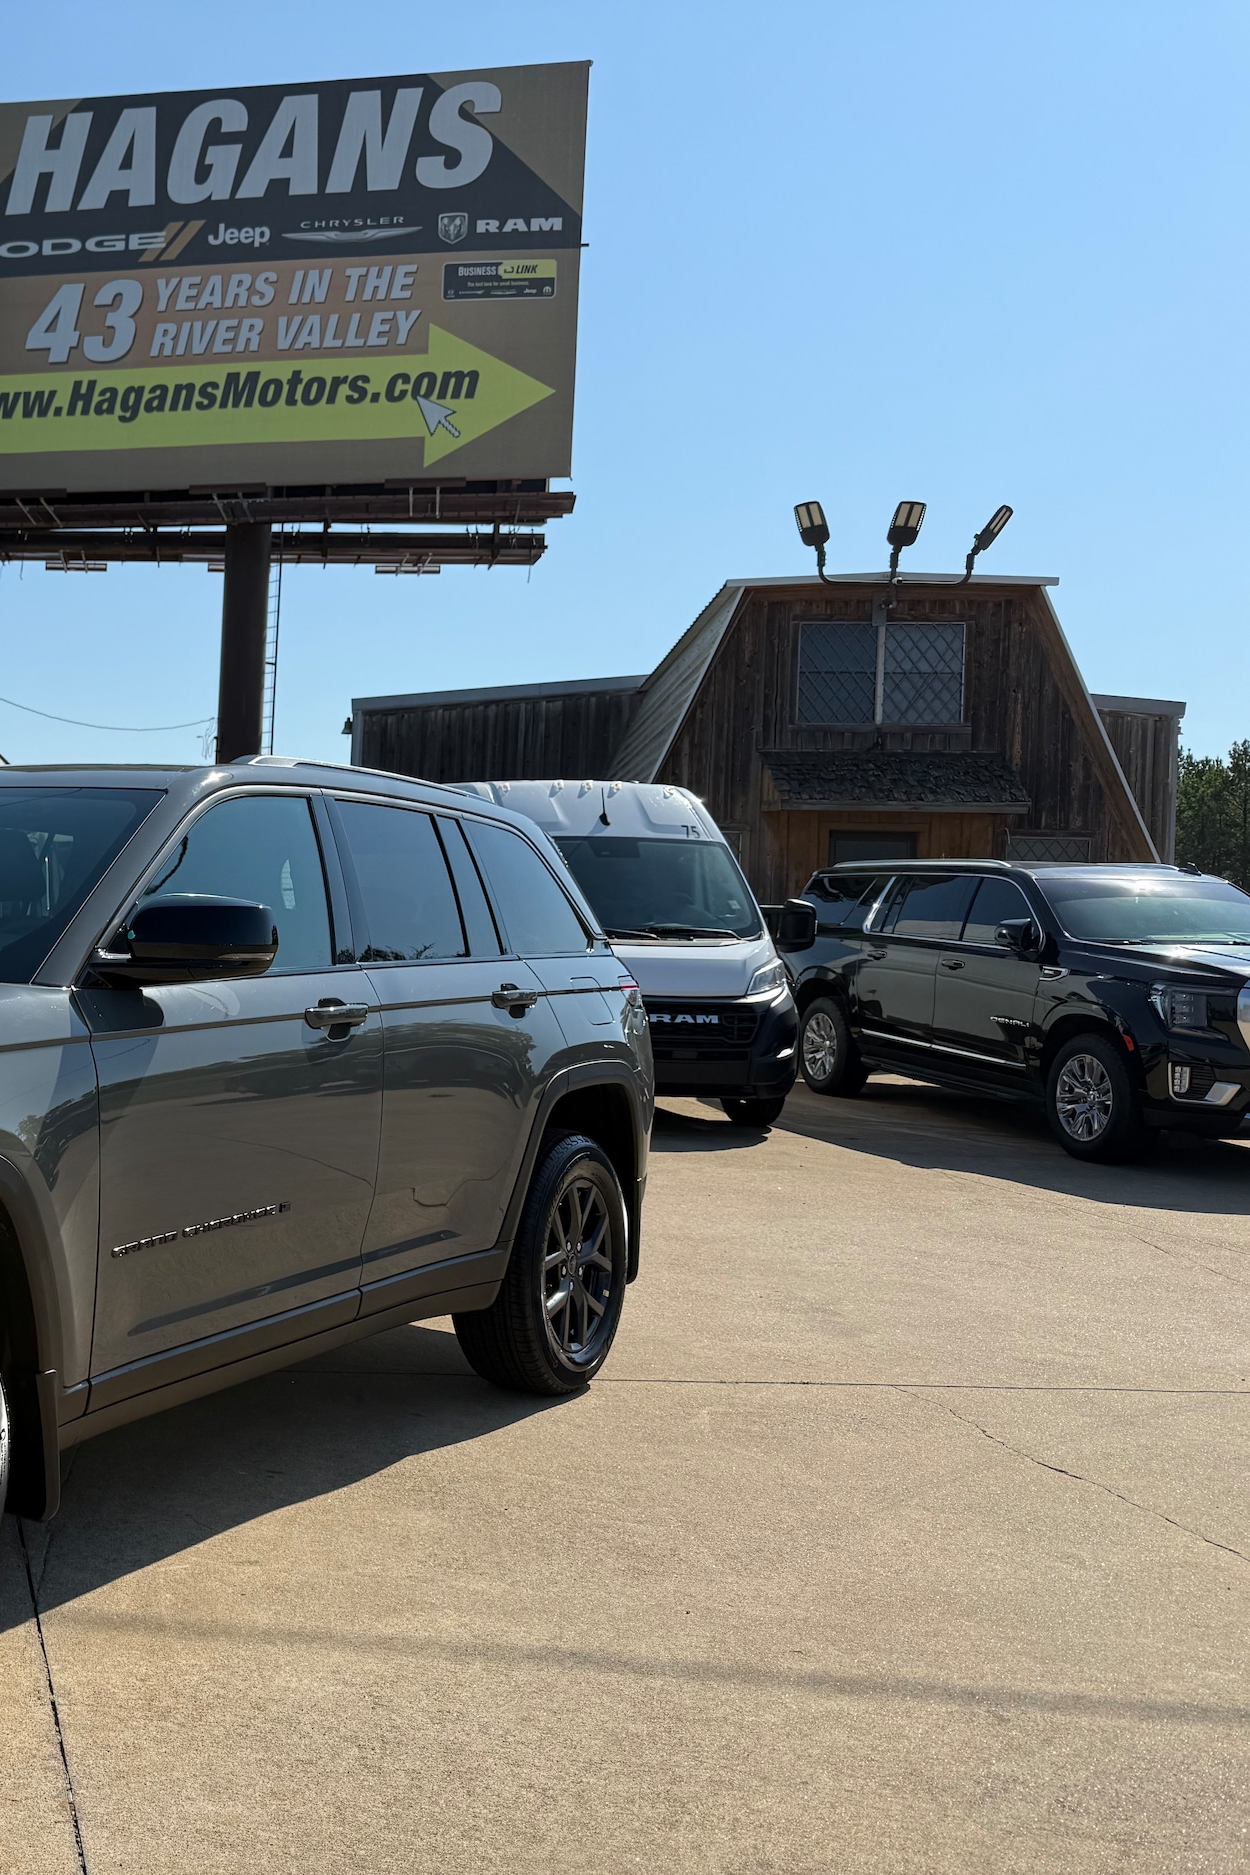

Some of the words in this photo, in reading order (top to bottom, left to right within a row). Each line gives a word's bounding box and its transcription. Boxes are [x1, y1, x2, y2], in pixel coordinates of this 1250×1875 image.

[4, 81, 502, 216] HAGANS
[300, 216, 405, 229] CHRYSLER
[476, 216, 563, 234] RAM
[207, 222, 270, 247] Jeep
[458, 266, 497, 276] BUSINESS
[515, 264, 539, 274] LINK
[25, 279, 140, 364] 43
[154, 271, 277, 312] YEARS
[287, 270, 325, 305] IN
[340, 264, 419, 302] THE
[150, 316, 263, 358] RIVER
[274, 309, 422, 351] VALLEY
[680, 824, 701, 839] 75
[649, 1013, 719, 1024] RAM
[989, 1016, 1030, 1028] DENALI
